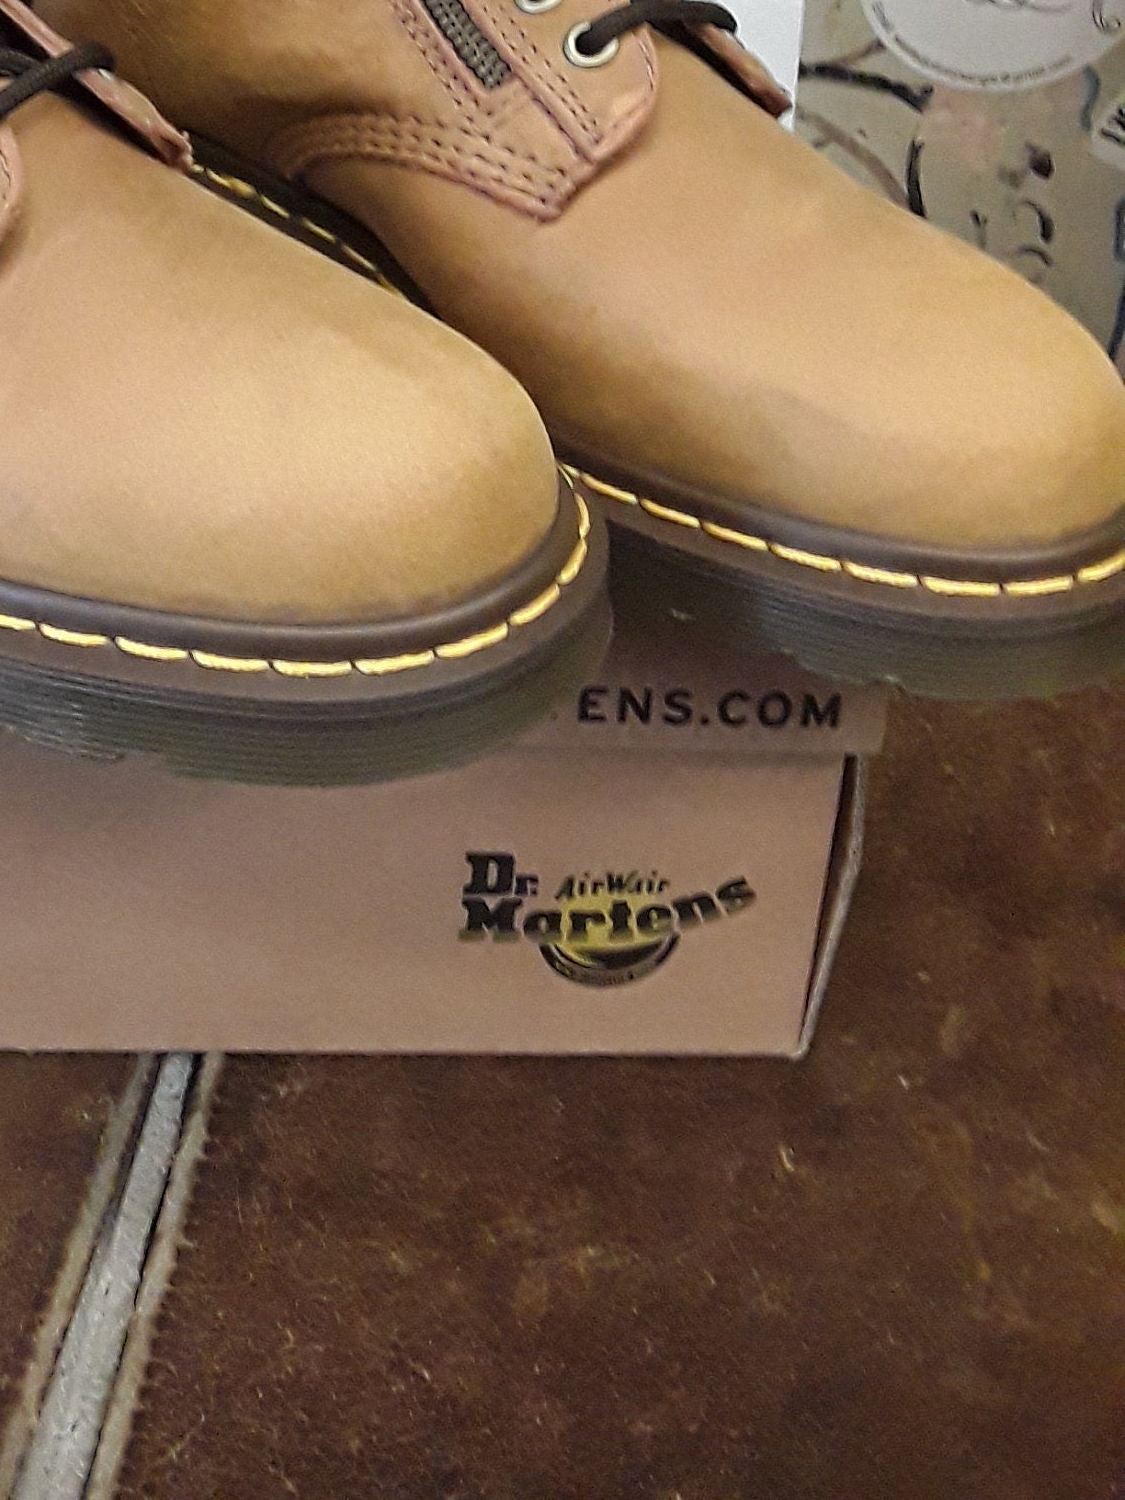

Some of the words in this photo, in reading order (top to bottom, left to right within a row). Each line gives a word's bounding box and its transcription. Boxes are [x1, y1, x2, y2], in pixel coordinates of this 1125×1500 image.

[577, 685, 841, 729] ENS.COM
[555, 870, 671, 901] AirWair
[458, 875, 758, 942] Martens
